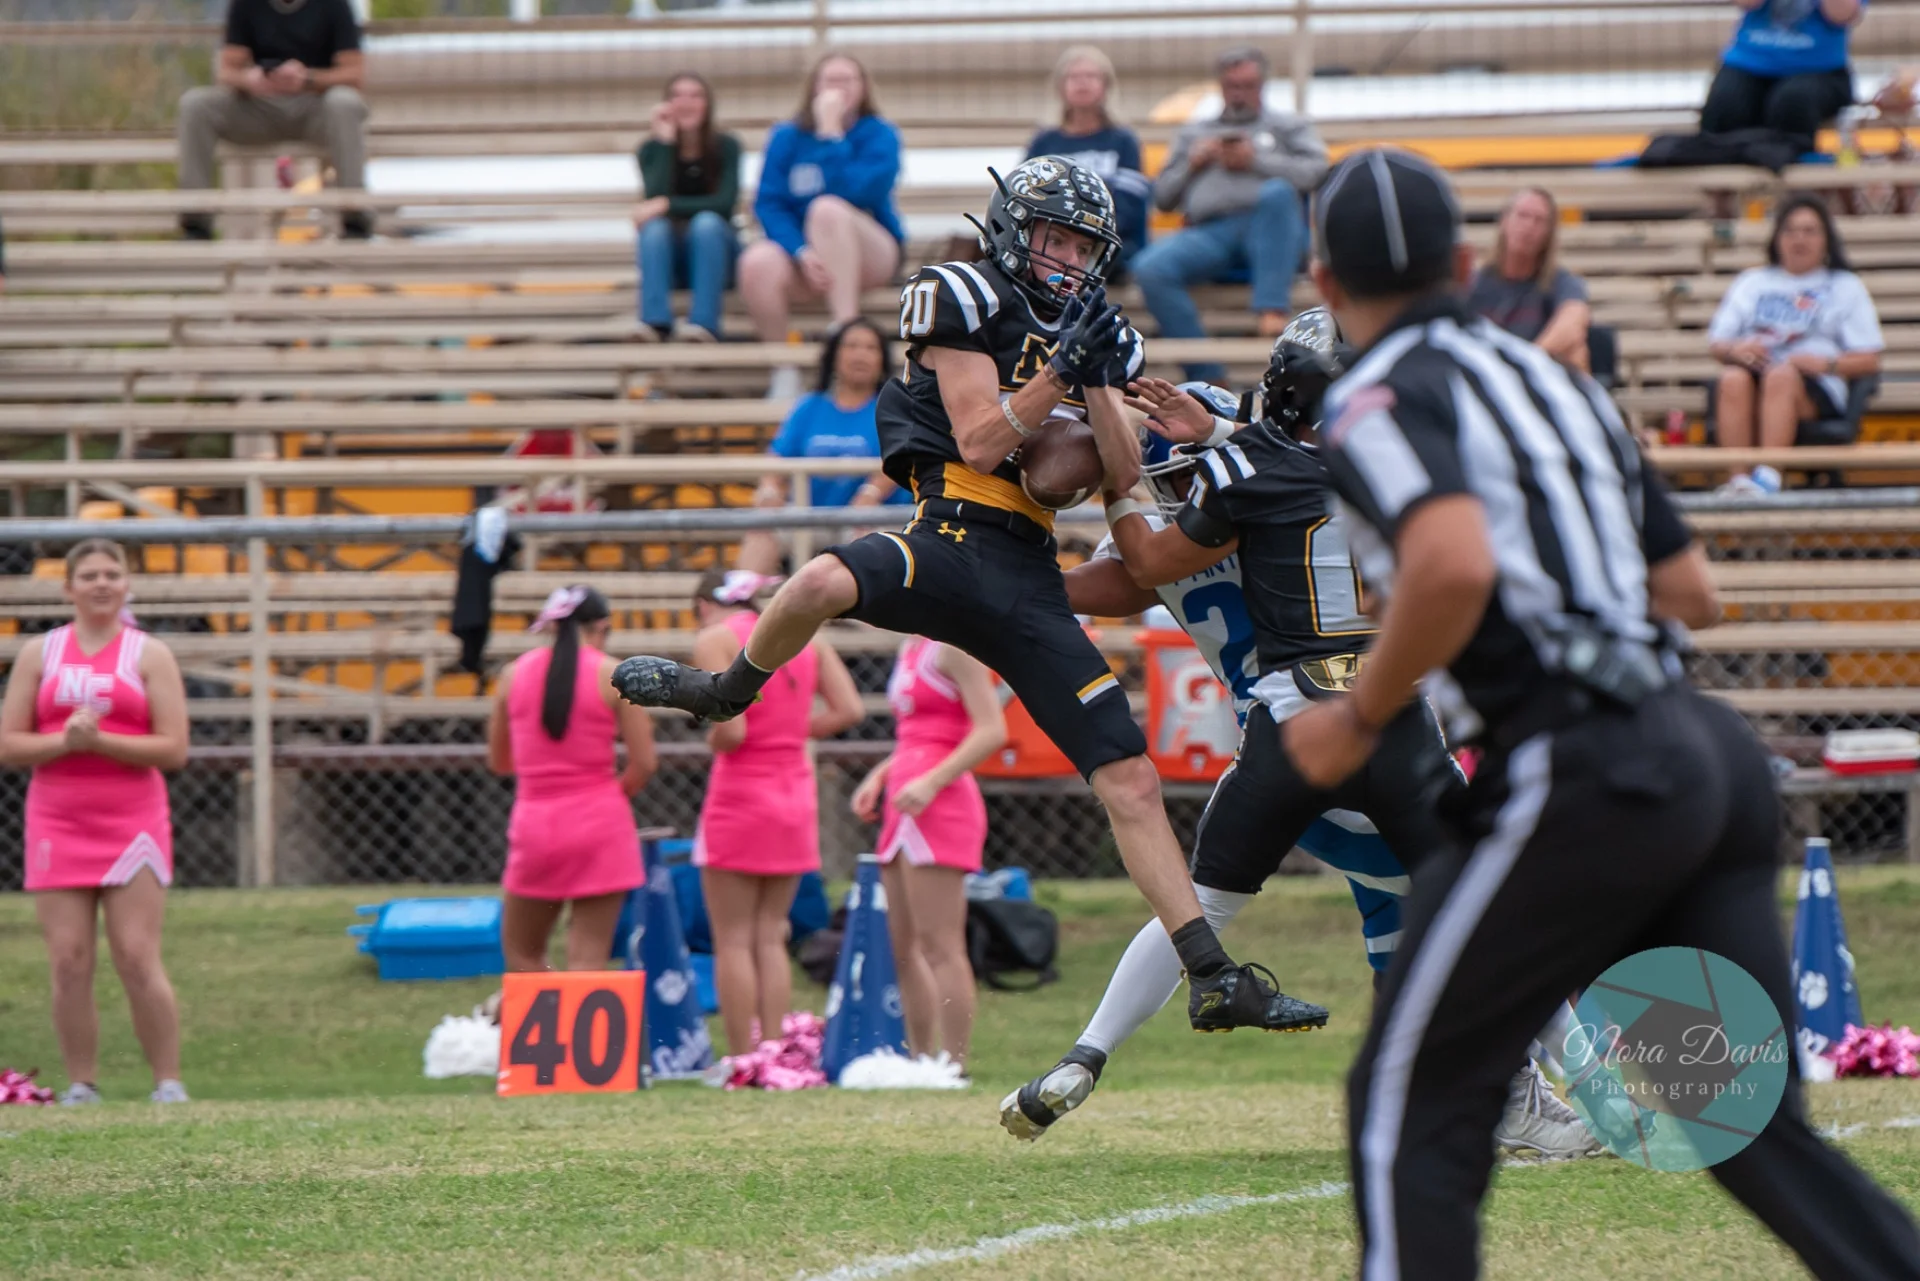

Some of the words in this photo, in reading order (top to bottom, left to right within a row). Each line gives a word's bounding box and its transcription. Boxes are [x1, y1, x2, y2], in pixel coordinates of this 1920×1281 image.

[900, 280, 940, 340] 20
[54, 663, 115, 716] NC
[1174, 663, 1223, 713] G
[510, 988, 627, 1087] 40
